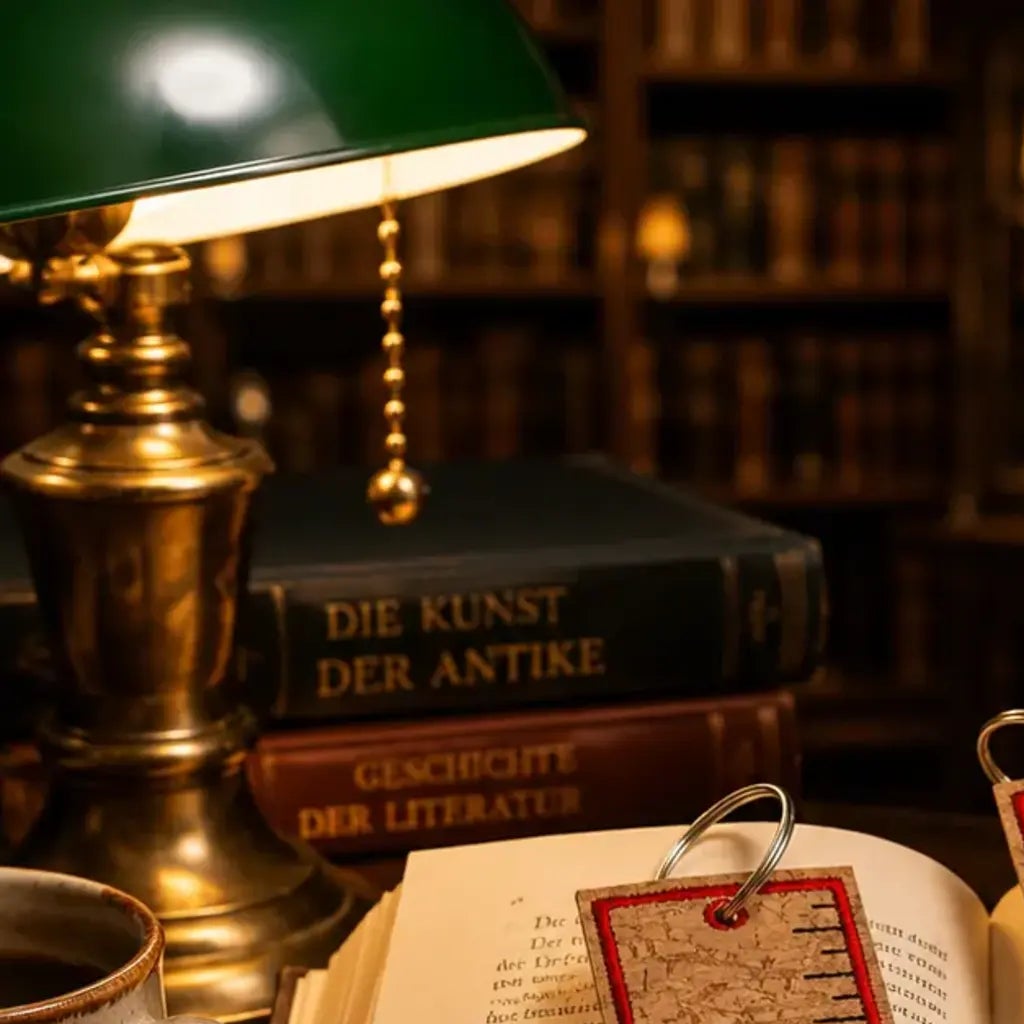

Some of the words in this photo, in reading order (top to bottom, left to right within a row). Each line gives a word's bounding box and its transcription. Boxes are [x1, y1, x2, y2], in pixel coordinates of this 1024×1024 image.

[328, 600, 403, 641] DIE
[421, 586, 567, 633] KUNST
[317, 656, 413, 698] DER
[431, 637, 606, 688] ANTIKE
[299, 804, 373, 839] DER
